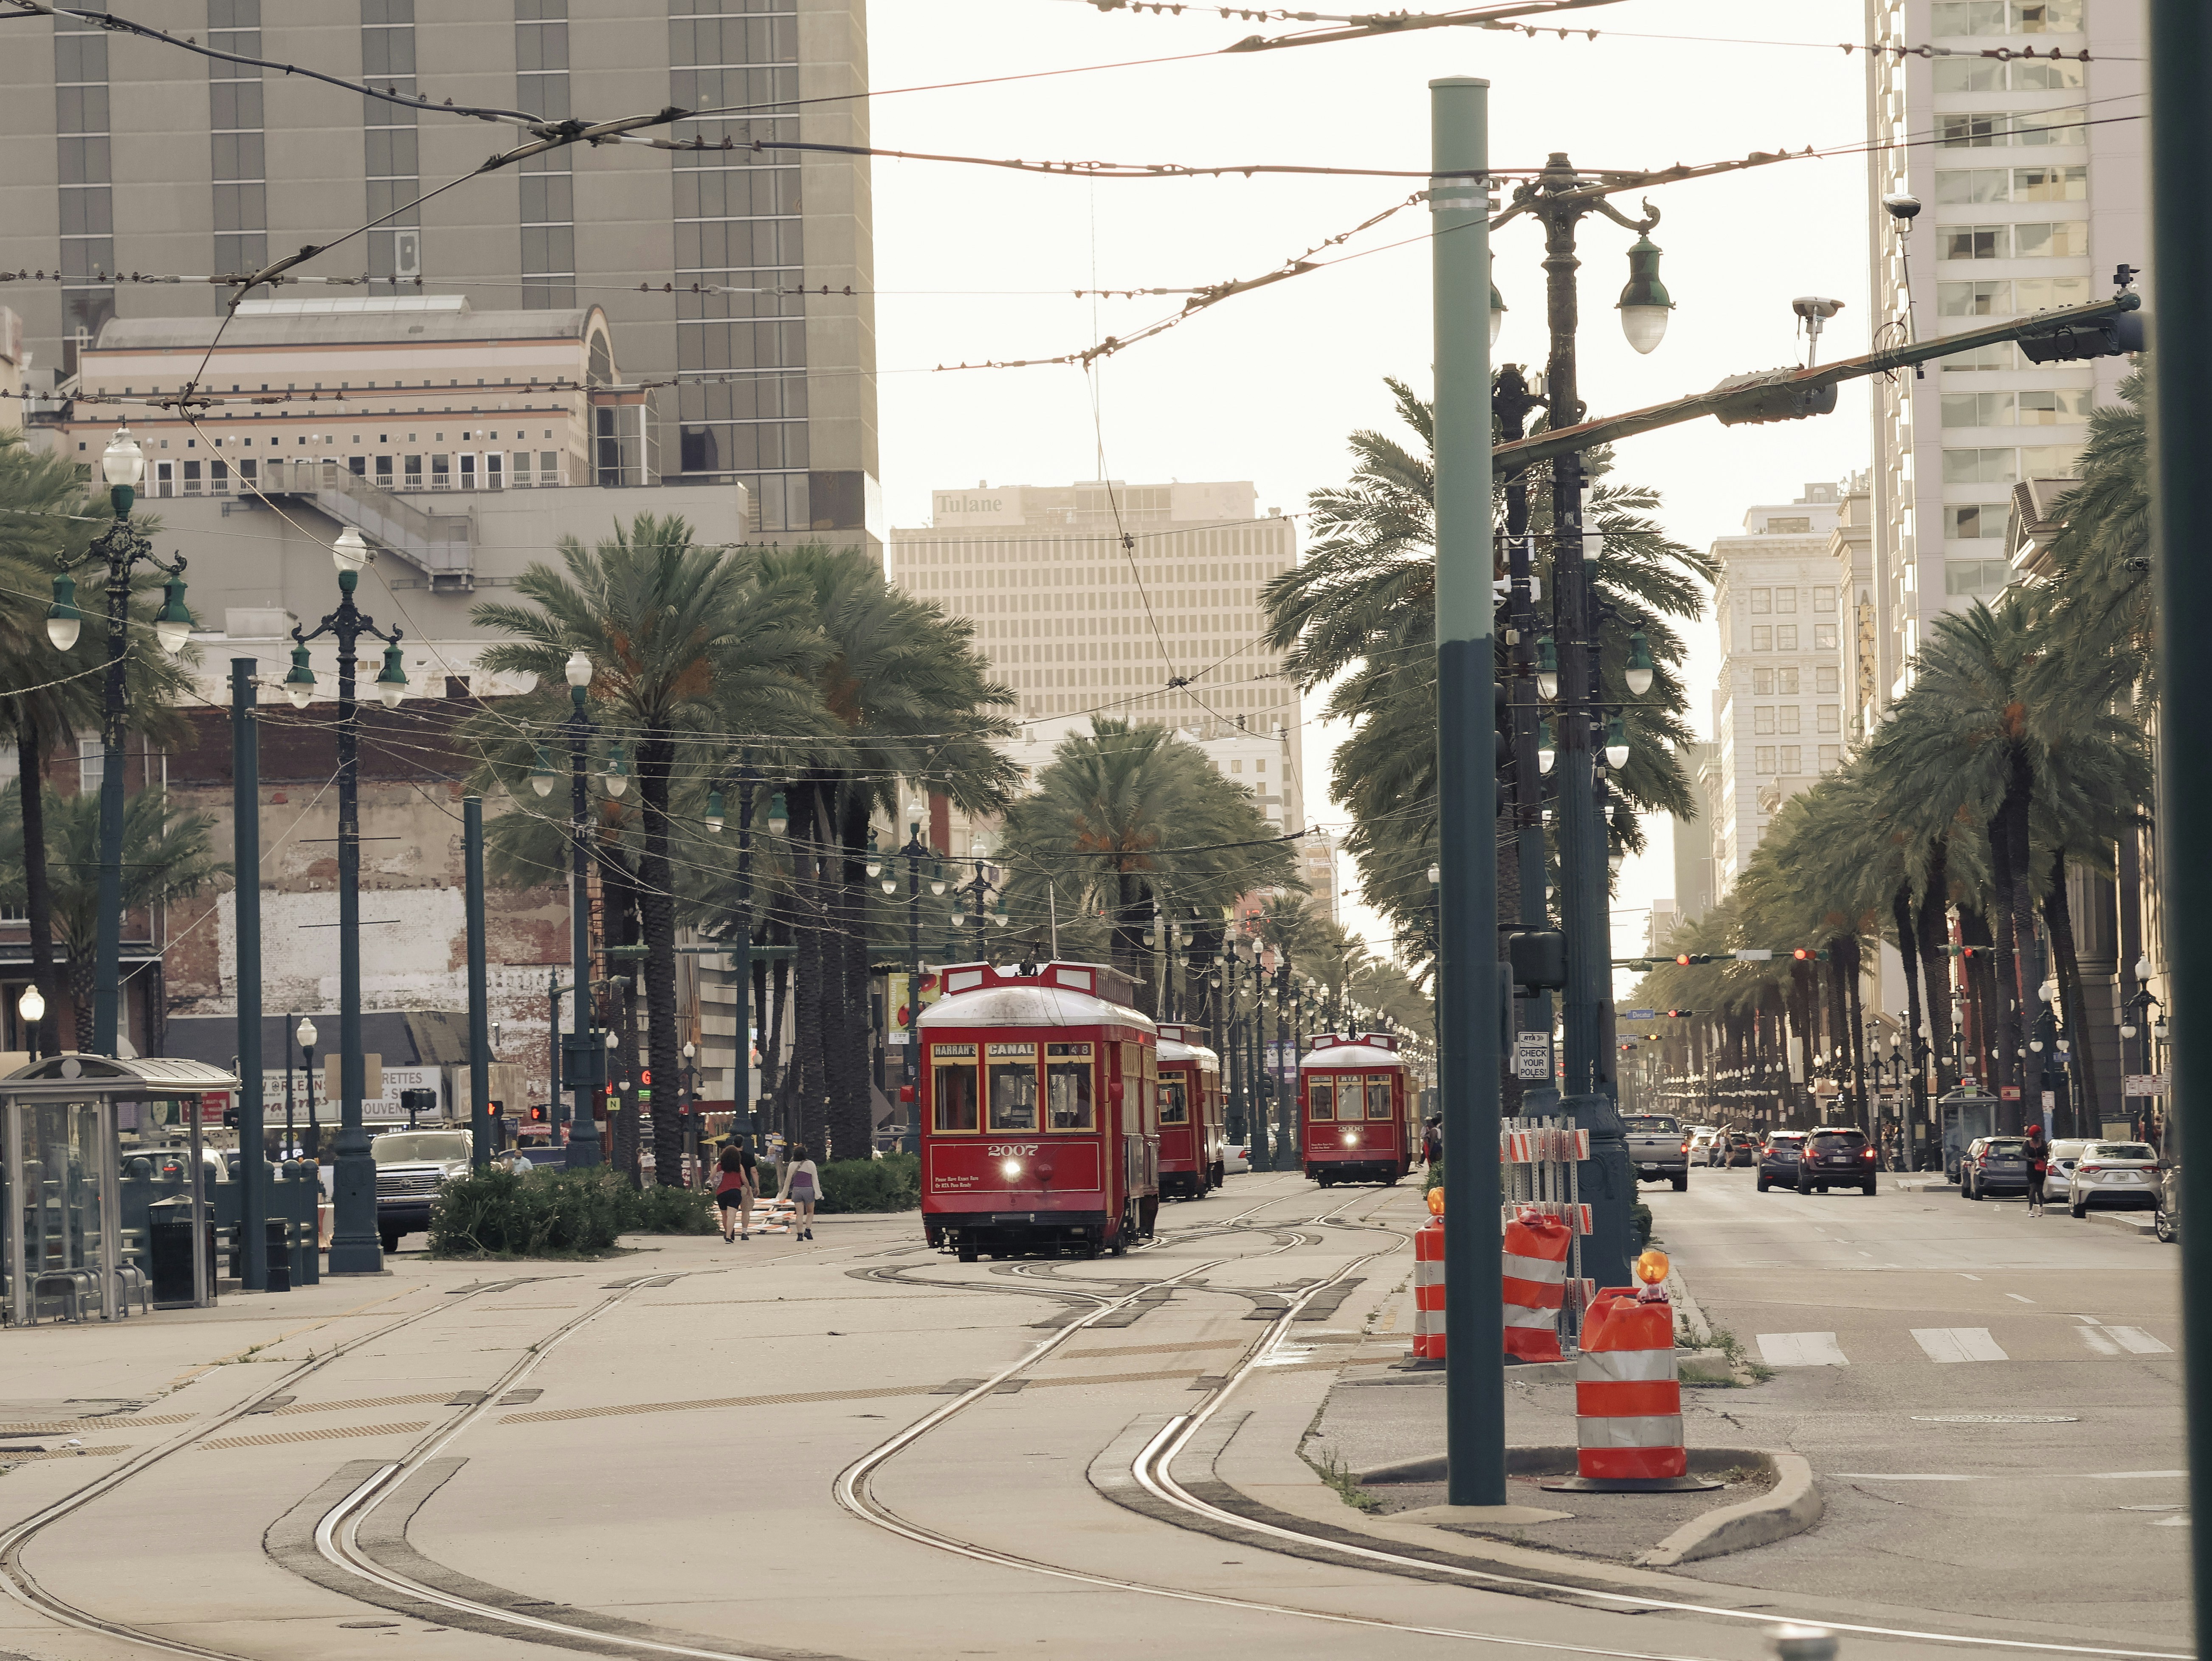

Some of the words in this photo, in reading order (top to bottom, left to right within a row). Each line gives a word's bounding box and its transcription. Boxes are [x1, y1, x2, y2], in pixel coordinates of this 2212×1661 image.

[937, 496, 1002, 513] Tulane
[935, 1045, 975, 1055] HARRAH'S
[989, 1044, 1034, 1055] CANAL
[382, 1072, 422, 1084] RETTES
[988, 1145, 1038, 1156] 2007
